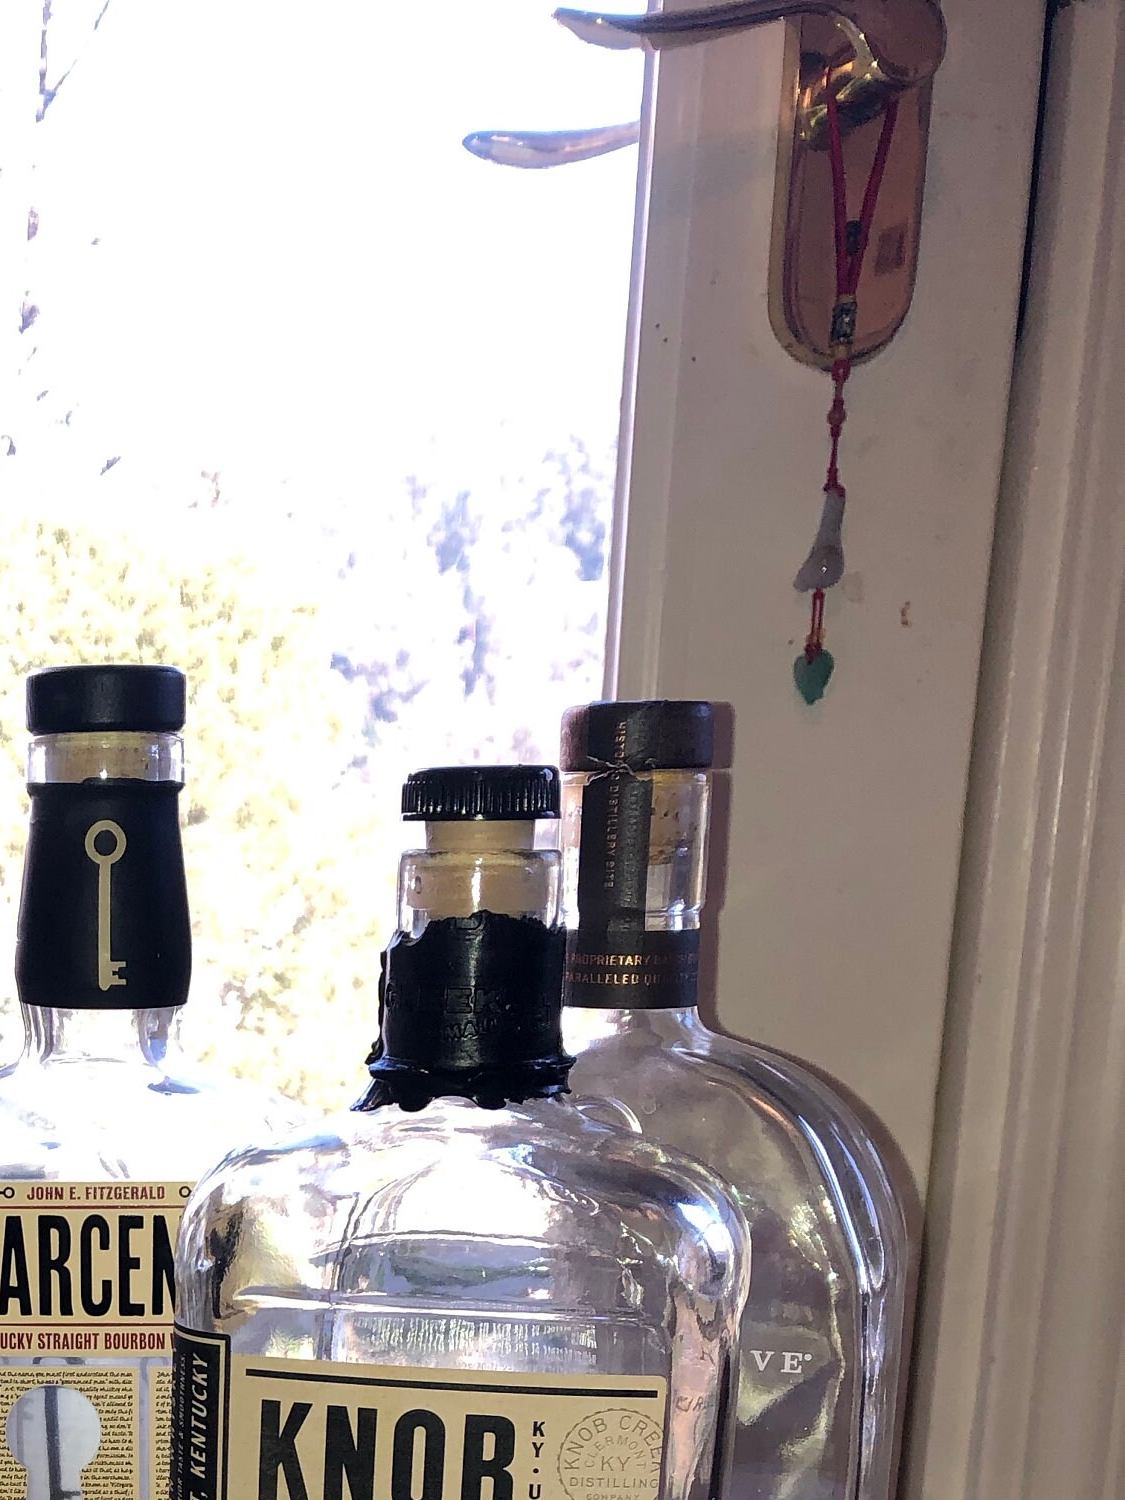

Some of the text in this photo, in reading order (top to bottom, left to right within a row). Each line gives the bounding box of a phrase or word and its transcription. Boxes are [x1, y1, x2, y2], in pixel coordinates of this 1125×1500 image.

[27, 1185, 165, 1201] JOHN E. FITZGERALD
[37, 1332, 100, 1350] STRAIGHT
[104, 1332, 166, 1350] BOURBON
[190, 1352, 208, 1479] KENTUCKY
[564, 1418, 607, 1470] KNOB
[584, 1434, 647, 1470] CLERMONT
[601, 1456, 630, 1471] KY
[570, 1477, 659, 1489] DISTILLING
